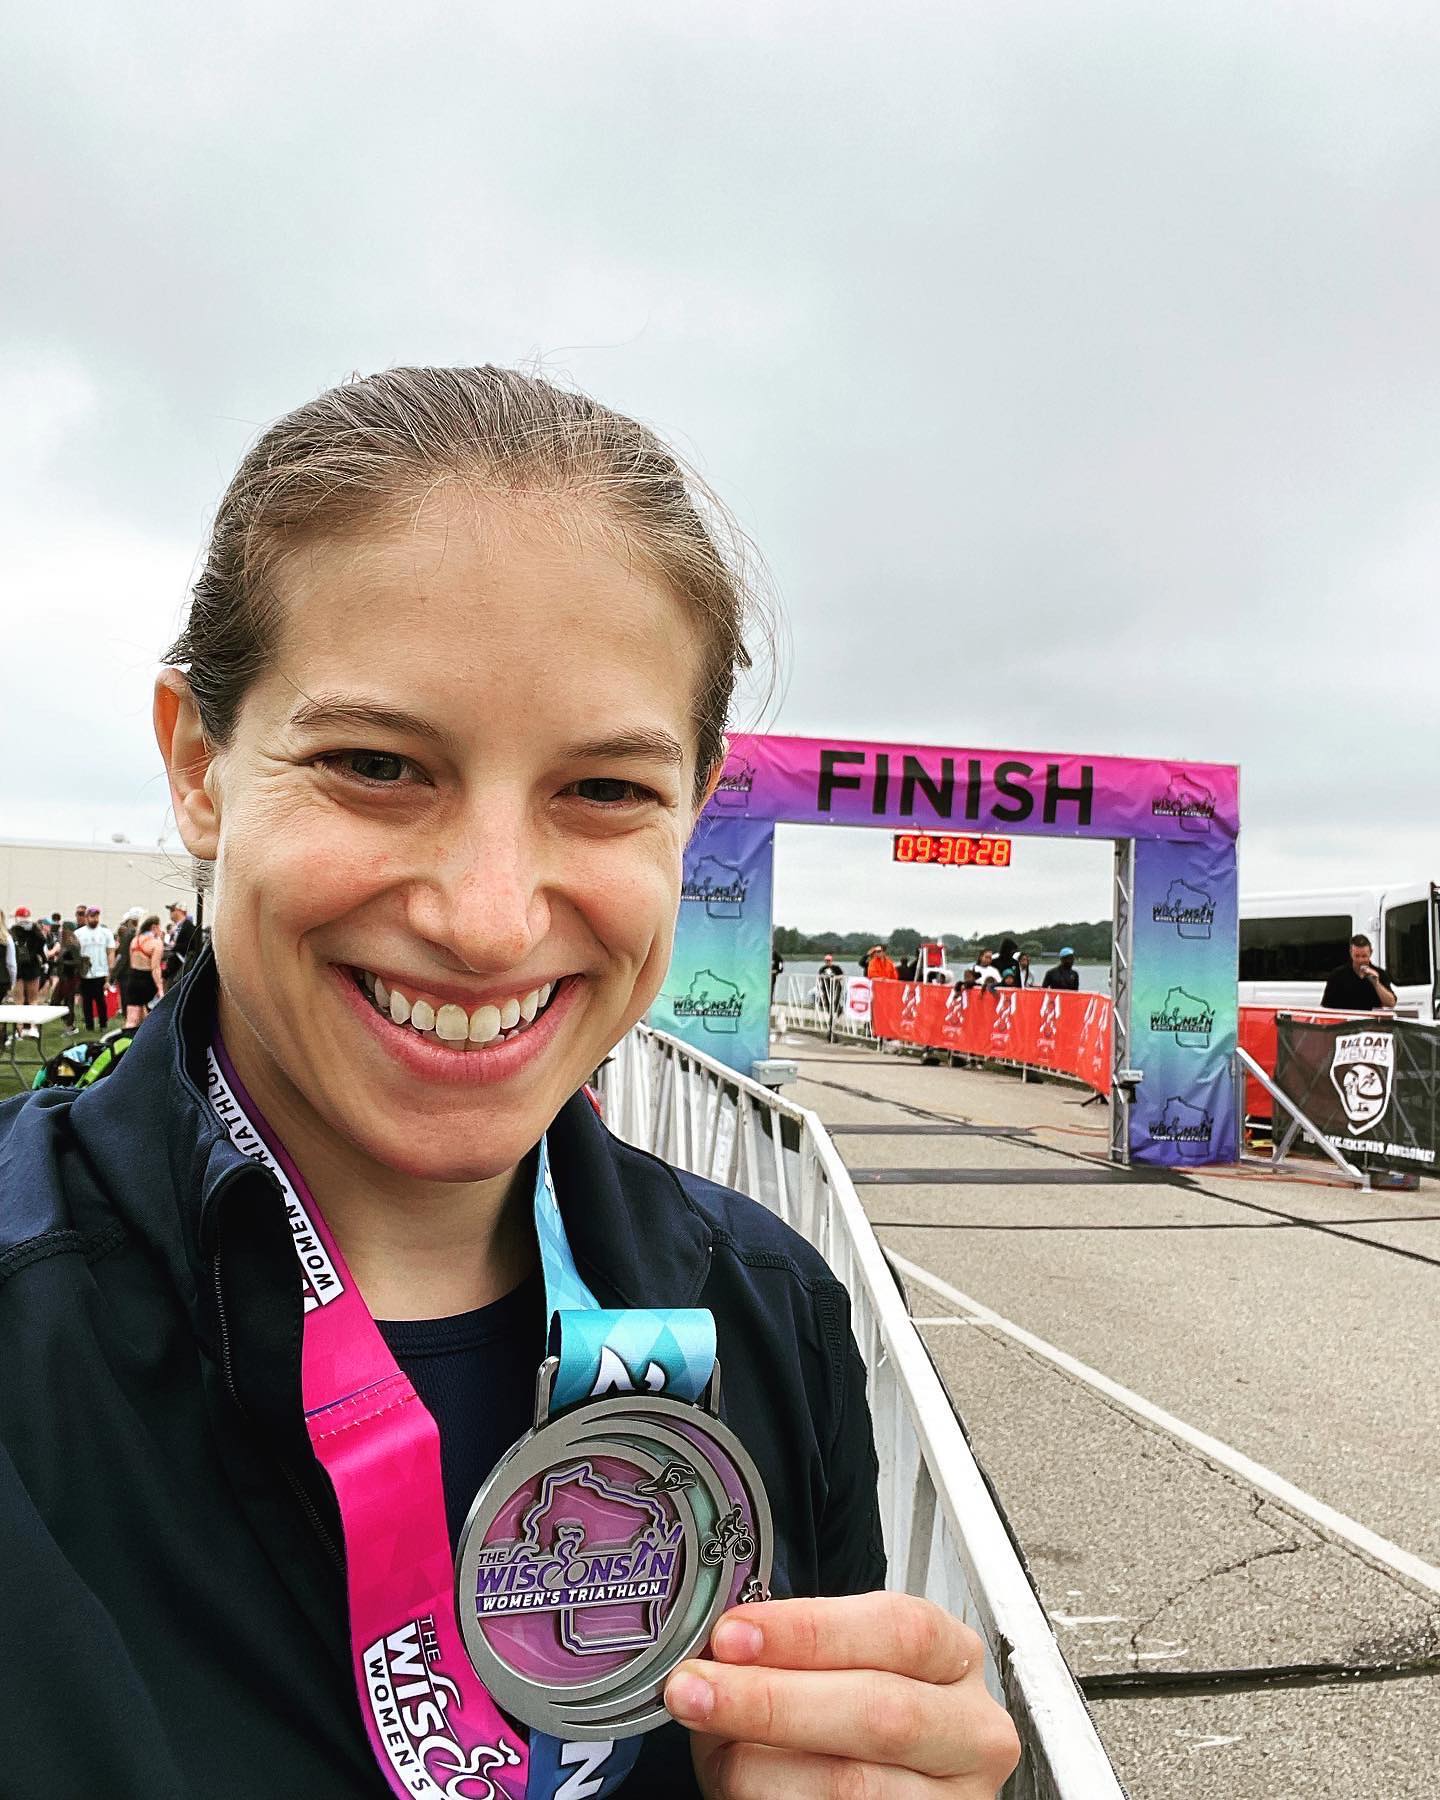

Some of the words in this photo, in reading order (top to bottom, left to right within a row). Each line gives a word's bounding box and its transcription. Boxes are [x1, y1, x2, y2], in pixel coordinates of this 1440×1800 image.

[817, 750, 1093, 825] FINISH
[897, 836, 1009, 865] 09:30:28
[674, 999, 743, 1010] WISCONSIN
[1364, 1036, 1389, 1048] DAY
[478, 1551, 507, 1563] THE
[476, 1549, 676, 1595] WISCONSIN
[483, 1591, 560, 1610] WOMEN'S
[569, 1582, 660, 1601] TRIATHLON
[421, 1614, 441, 1662] THE
[369, 1657, 431, 1791] WOMEN'S
